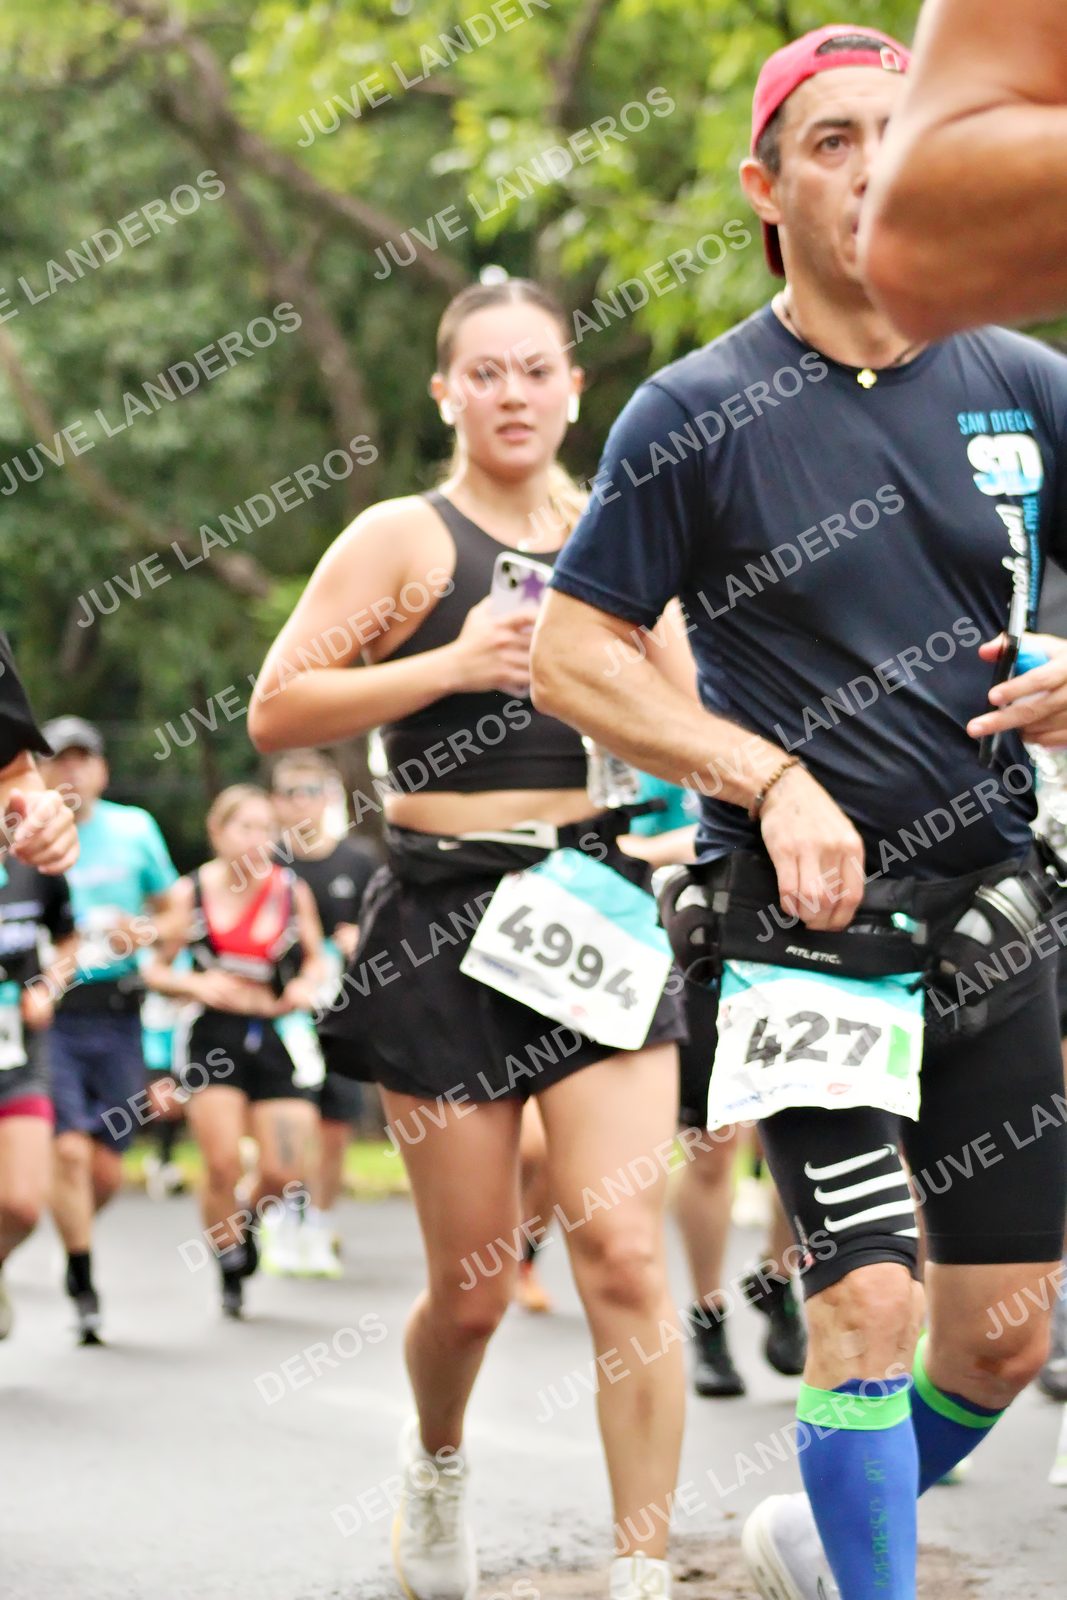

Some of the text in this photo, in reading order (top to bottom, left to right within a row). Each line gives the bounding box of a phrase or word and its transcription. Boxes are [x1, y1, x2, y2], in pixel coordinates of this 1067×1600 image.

[957, 411, 987, 435] SAN
[498, 905, 639, 1010] 4994
[744, 1010, 882, 1069] 427
